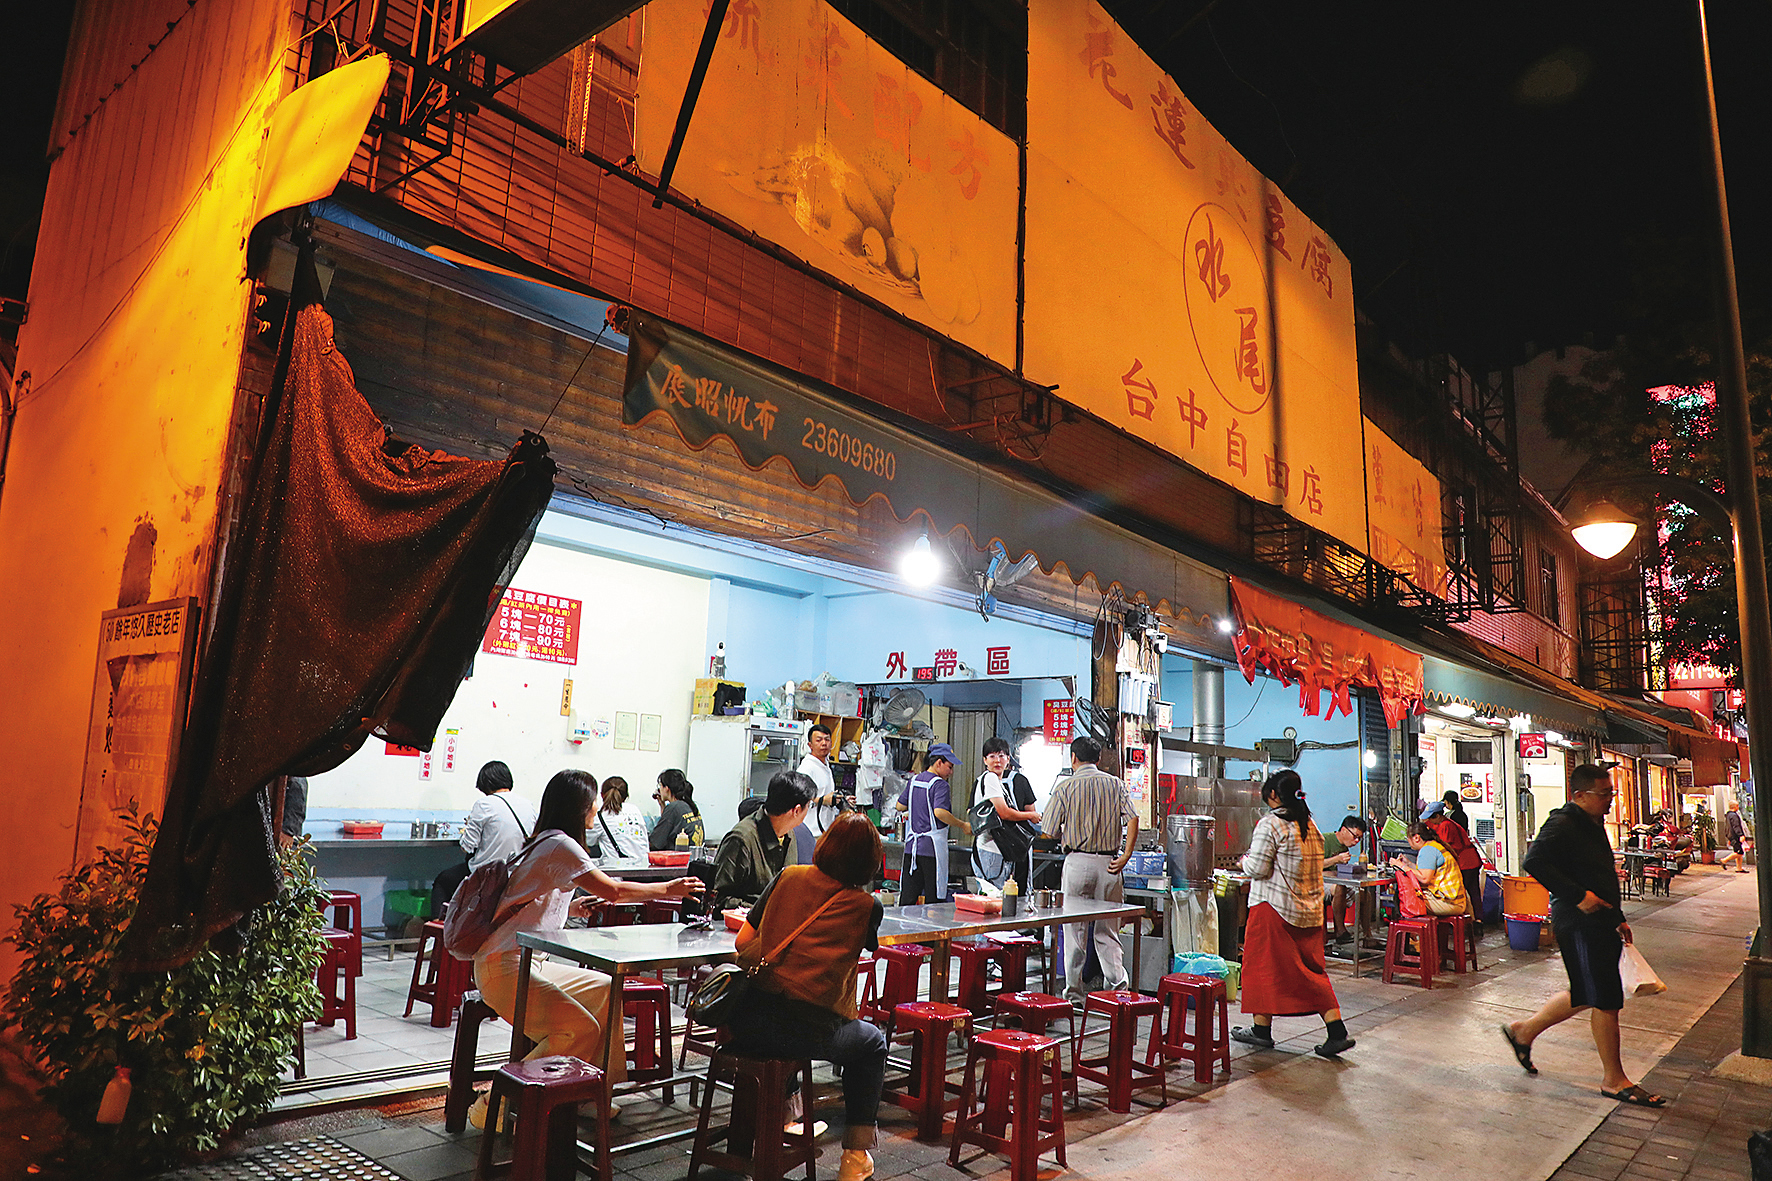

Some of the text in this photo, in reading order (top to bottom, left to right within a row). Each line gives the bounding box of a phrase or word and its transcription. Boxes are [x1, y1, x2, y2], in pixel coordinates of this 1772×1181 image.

[1195, 212, 1266, 395] 水尾
[802, 418, 897, 481] 23609680
[1121, 358, 1324, 517] 台中自由店
[886, 646, 1012, 680] 外帶區
[916, 667, 933, 680] 195
[422, 753, 432, 778] 心地滑
[1132, 749, 1145, 763] 195
